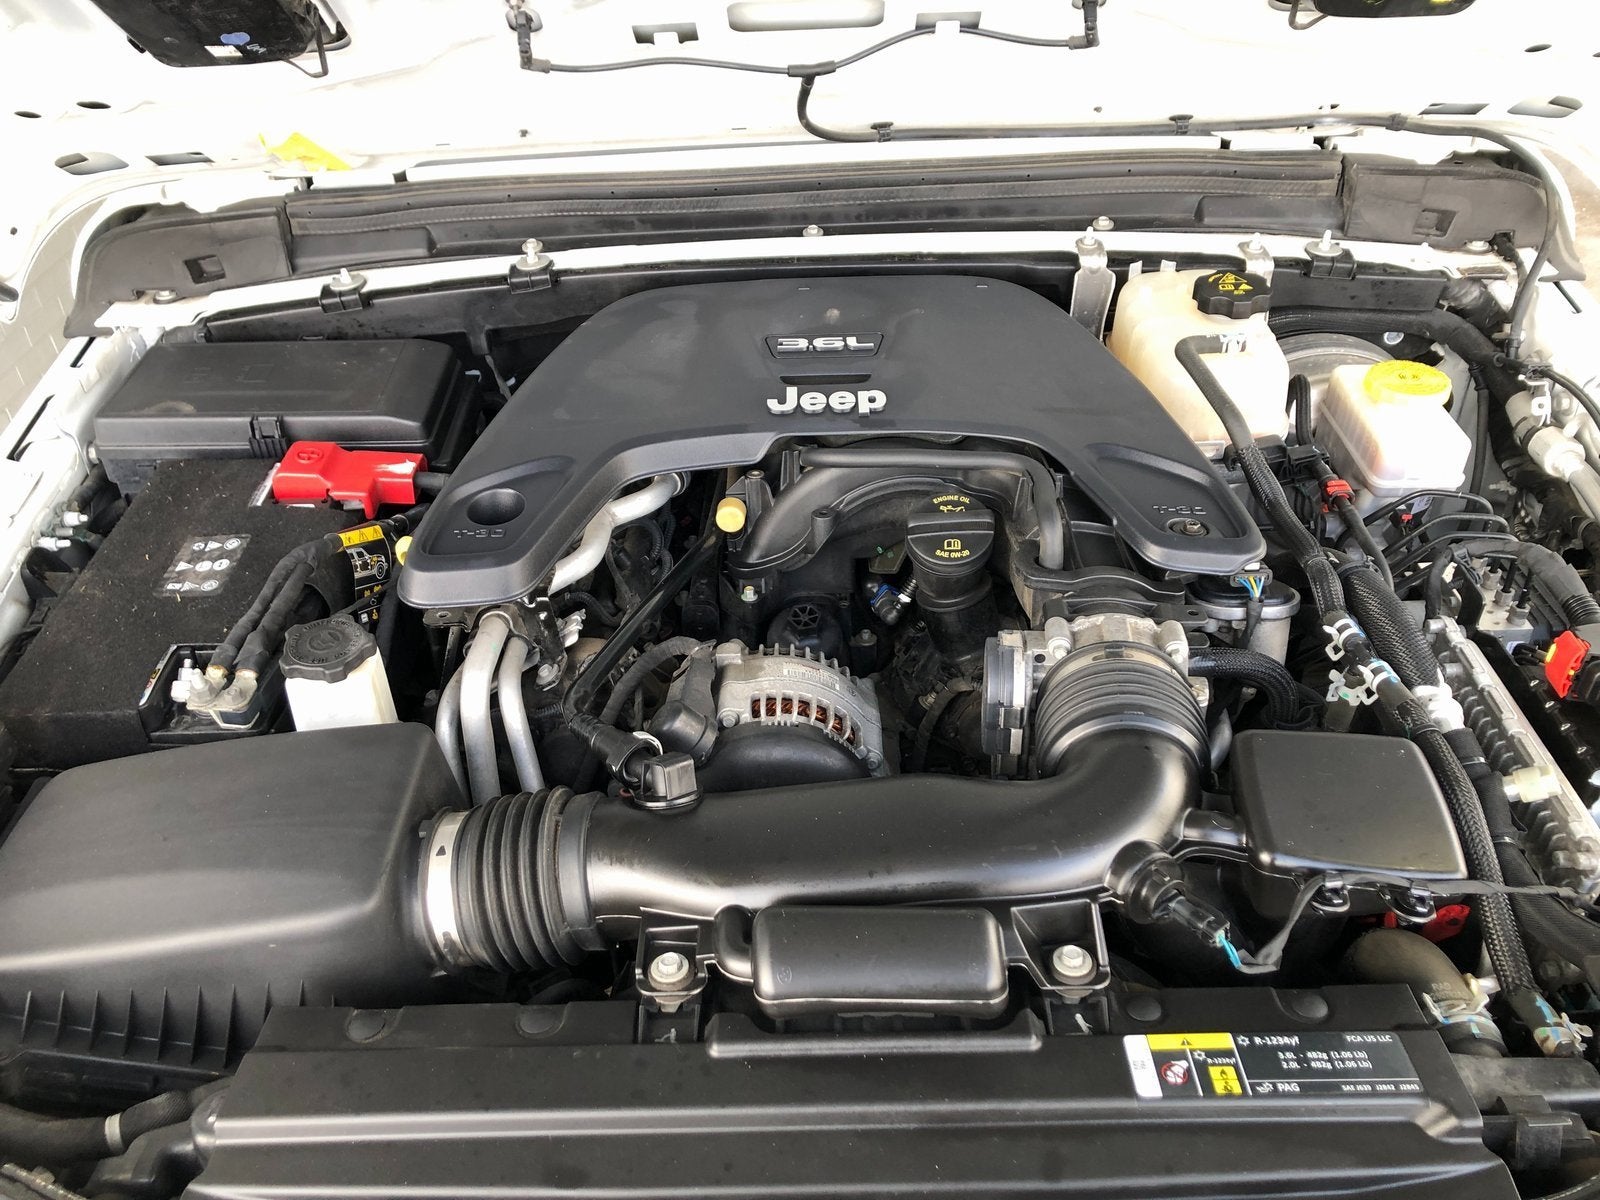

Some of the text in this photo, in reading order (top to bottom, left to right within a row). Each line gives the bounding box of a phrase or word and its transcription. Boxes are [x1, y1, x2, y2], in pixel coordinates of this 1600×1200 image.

[776, 336, 874, 352] 3.6L
[766, 386, 887, 417] Jeep
[932, 495, 970, 504] ENGINE OIL
[935, 549, 970, 558] SAE 0W-20
[1253, 1035, 1300, 1046] R-1234yf
[1277, 1051, 1297, 1059] 3.6L
[1306, 1051, 1329, 1060] 482g
[1281, 1061, 1301, 1069] 2.0L
[1310, 1061, 1333, 1070] 482g
[1276, 1082, 1301, 1092] PAG
